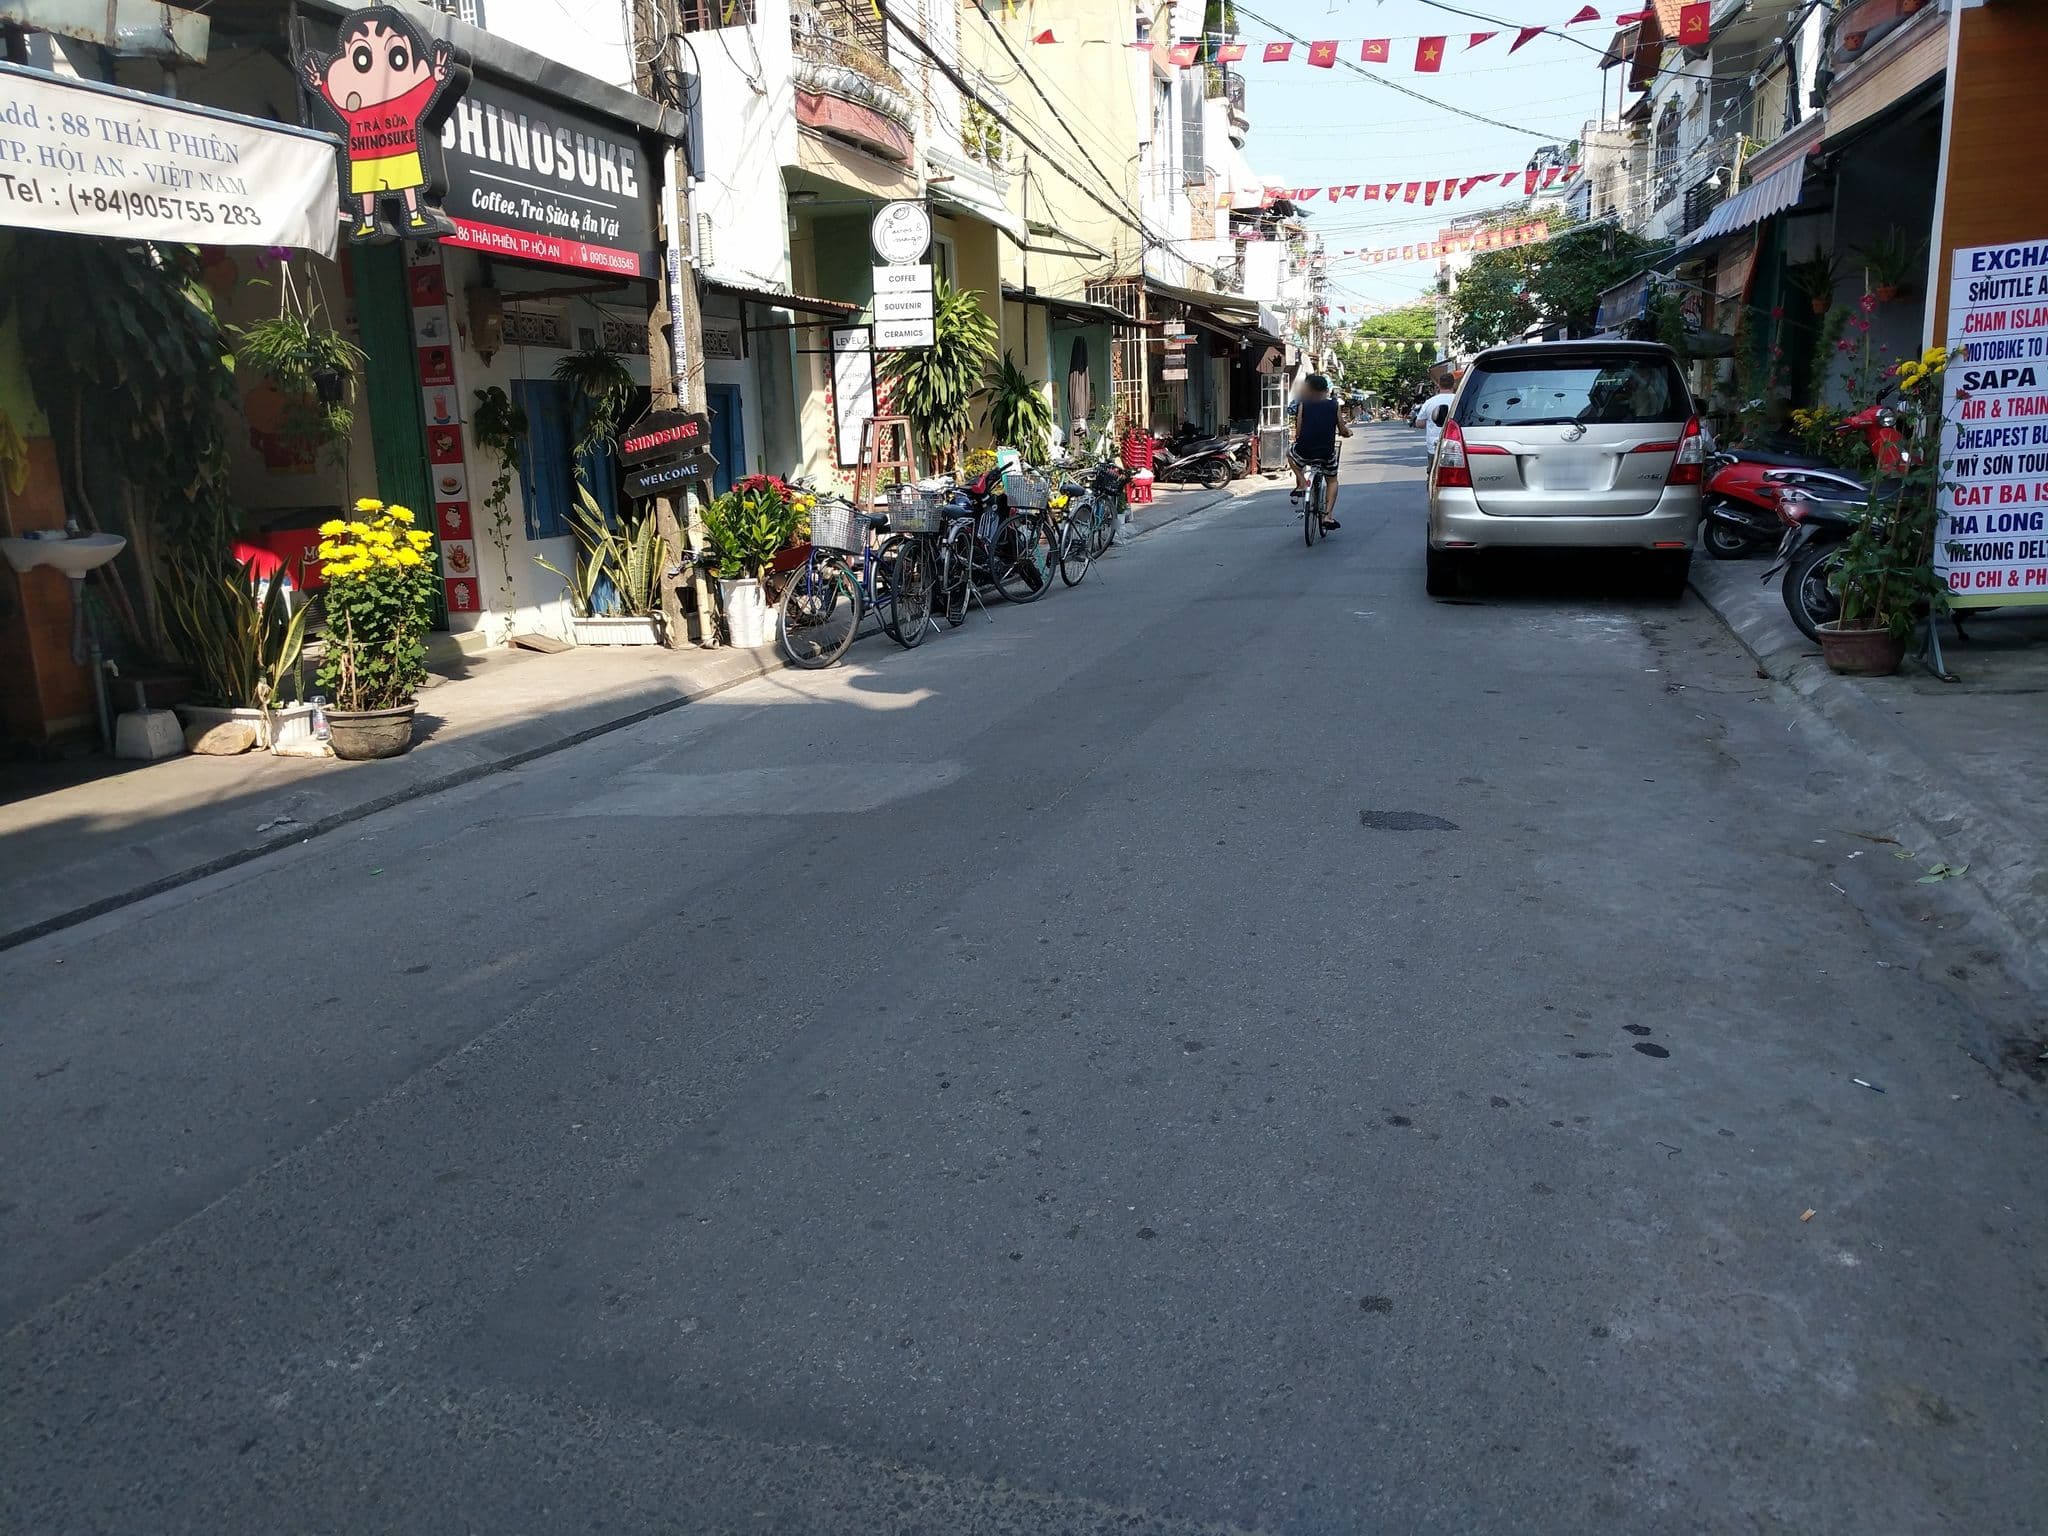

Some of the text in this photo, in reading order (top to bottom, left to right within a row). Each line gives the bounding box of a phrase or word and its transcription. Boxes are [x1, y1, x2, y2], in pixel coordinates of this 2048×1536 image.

[61, 112, 90, 138] 88
[95, 117, 163, 150] THÁI
[165, 132, 240, 165] PHIÊN
[350, 129, 416, 151] SHINOSUKE
[0, 138, 32, 164] TP.
[36, 142, 87, 177] HỘI
[93, 155, 126, 178] AN
[142, 160, 194, 192] VIỆT
[200, 172, 249, 196] NAM
[0, 173, 43, 204] Tel
[219, 203, 262, 226] 283
[471, 187, 520, 219] Coffee,
[521, 197, 544, 222] Trà
[570, 210, 580, 230] &
[581, 208, 598, 233] Ăn
[457, 226, 470, 241] 86
[471, 229, 491, 245] THÁI
[547, 245, 560, 258] AN
[888, 274, 916, 283] COFFEE
[1968, 276, 2034, 302] SHUTTLE
[884, 302, 922, 311] SOUVENIR
[884, 329, 923, 338] CERAMICS
[1965, 310, 2007, 334] CHAM
[835, 336, 861, 346] LEVEL
[1963, 337, 2043, 363] MOTOBIKE TO
[1962, 367, 2037, 391] SAPA
[1961, 396, 2048, 420] AIR & TRAIN
[624, 421, 699, 454] SHINOSUKE
[1956, 426, 2029, 450] CHEAPEST
[639, 463, 699, 487] WELCOME
[1956, 454, 1979, 478] MỸ
[1982, 454, 2014, 476] SƠN
[1954, 484, 1994, 506] CAT
[1999, 484, 2027, 504] BA
[1950, 511, 2044, 535] HA LONG
[1949, 540, 2048, 563] MEKONG DEL
[1949, 568, 2048, 589] CU CHI & PH
